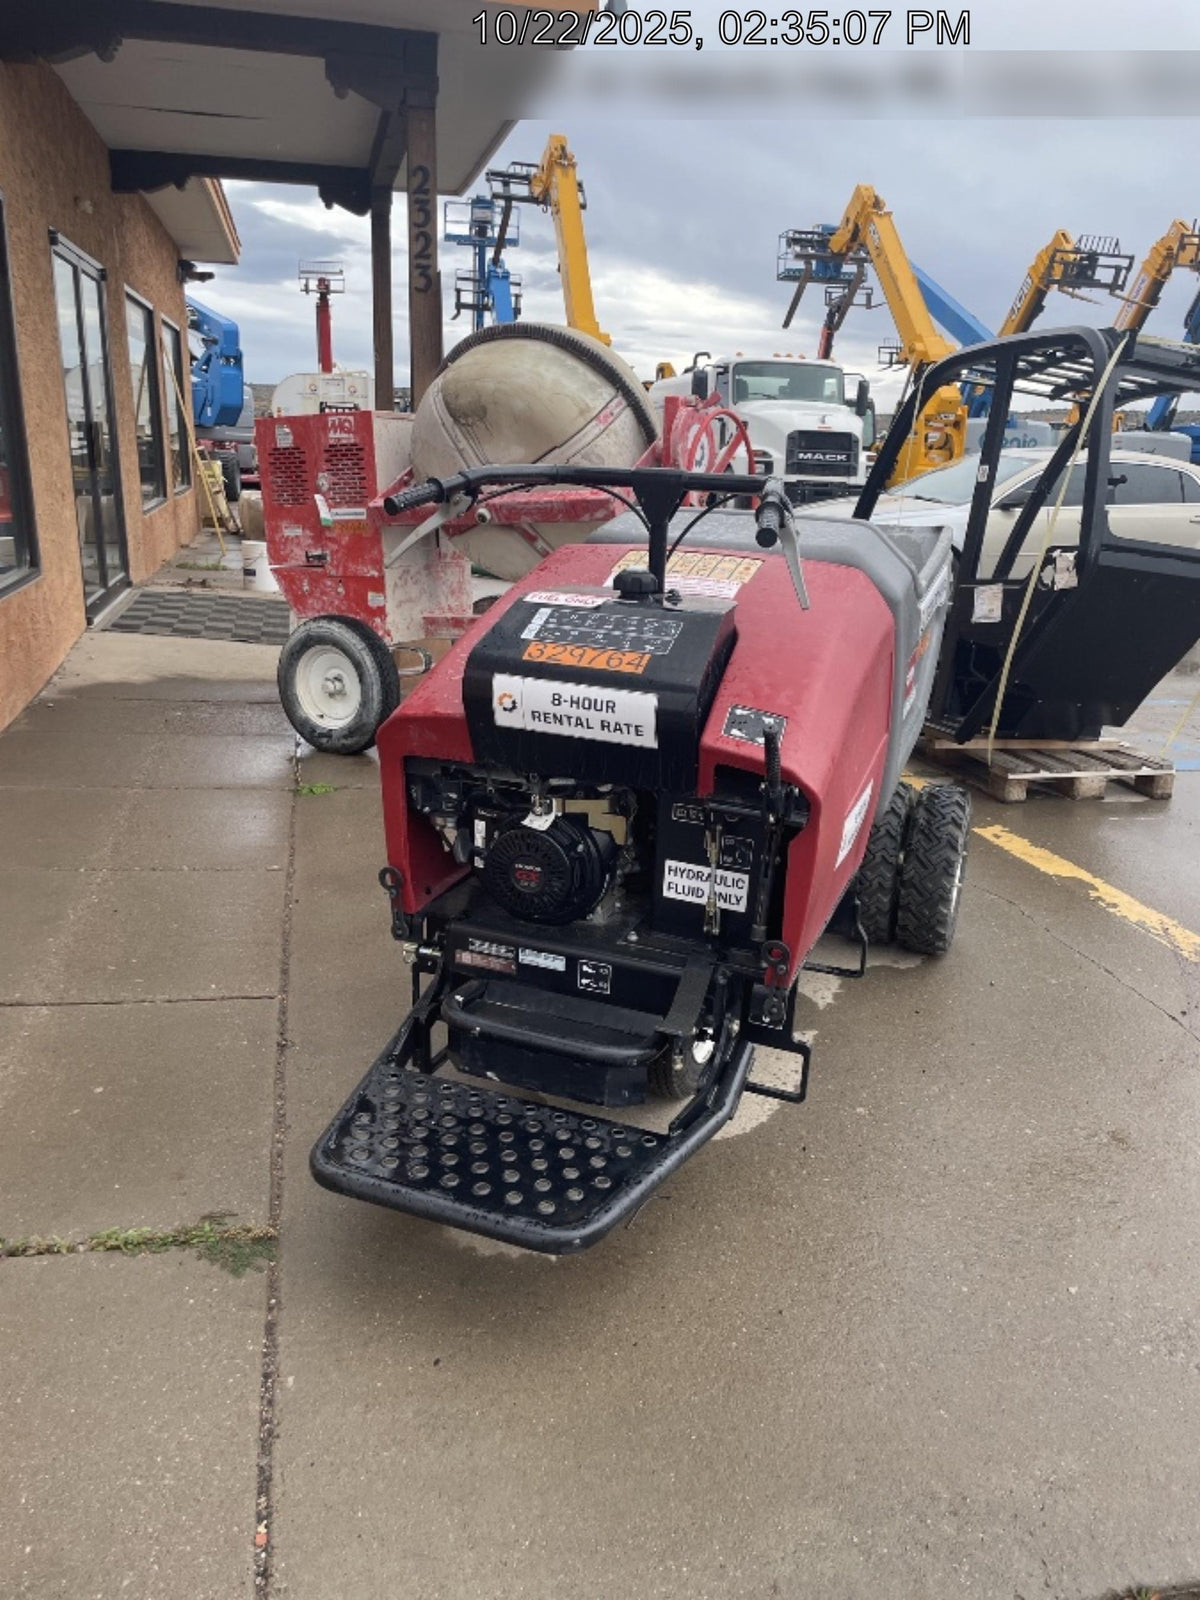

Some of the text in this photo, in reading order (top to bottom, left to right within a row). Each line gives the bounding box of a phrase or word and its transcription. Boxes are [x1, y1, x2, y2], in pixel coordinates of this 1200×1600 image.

[411, 165, 433, 293] 2323
[798, 452, 848, 462] MACK
[551, 692, 617, 714] 8-HOUR
[531, 710, 645, 737] RENTAL RATE
[667, 881, 744, 906] FLUID NLY
